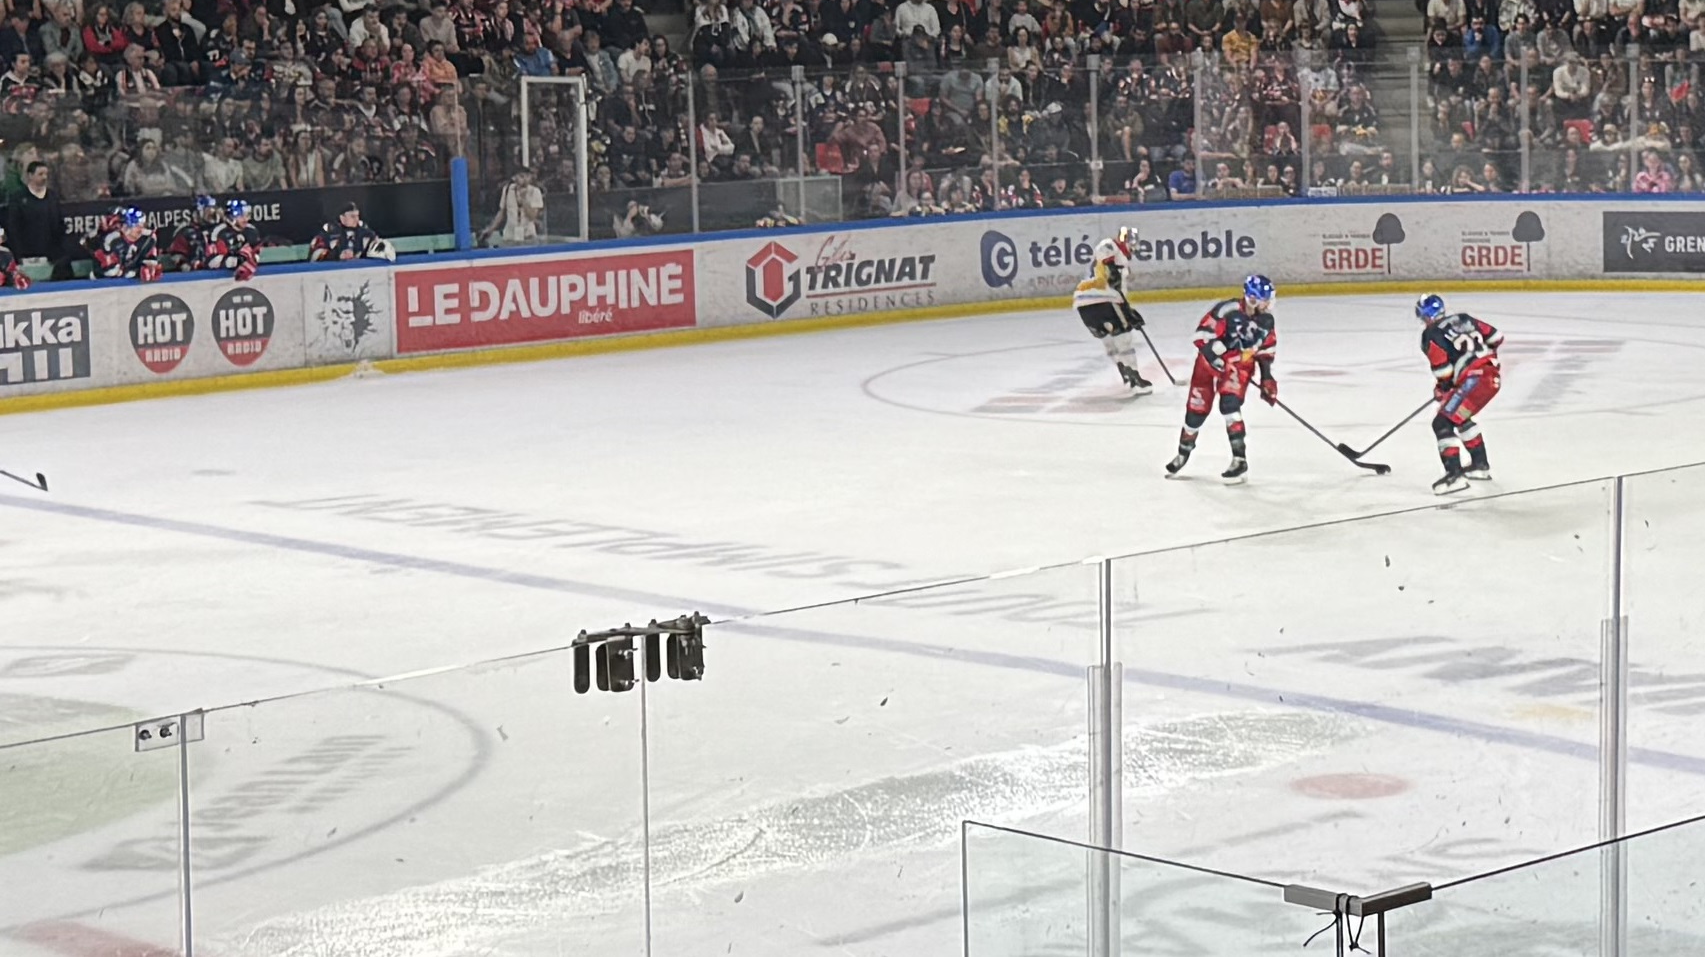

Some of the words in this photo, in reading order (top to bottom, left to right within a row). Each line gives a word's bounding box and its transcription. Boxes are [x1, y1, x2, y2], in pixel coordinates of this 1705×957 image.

[1029, 229, 1256, 268] téléenoble
[1322, 248, 1384, 270] GRDE
[1461, 245, 1523, 267] GRDE
[805, 254, 936, 291] TRIGNAT
[408, 283, 461, 327] LE
[469, 262, 684, 323] DAUPHINÉ
[0, 311, 83, 348] kka
[136, 313, 187, 345] HOT
[219, 307, 268, 337] HOT
